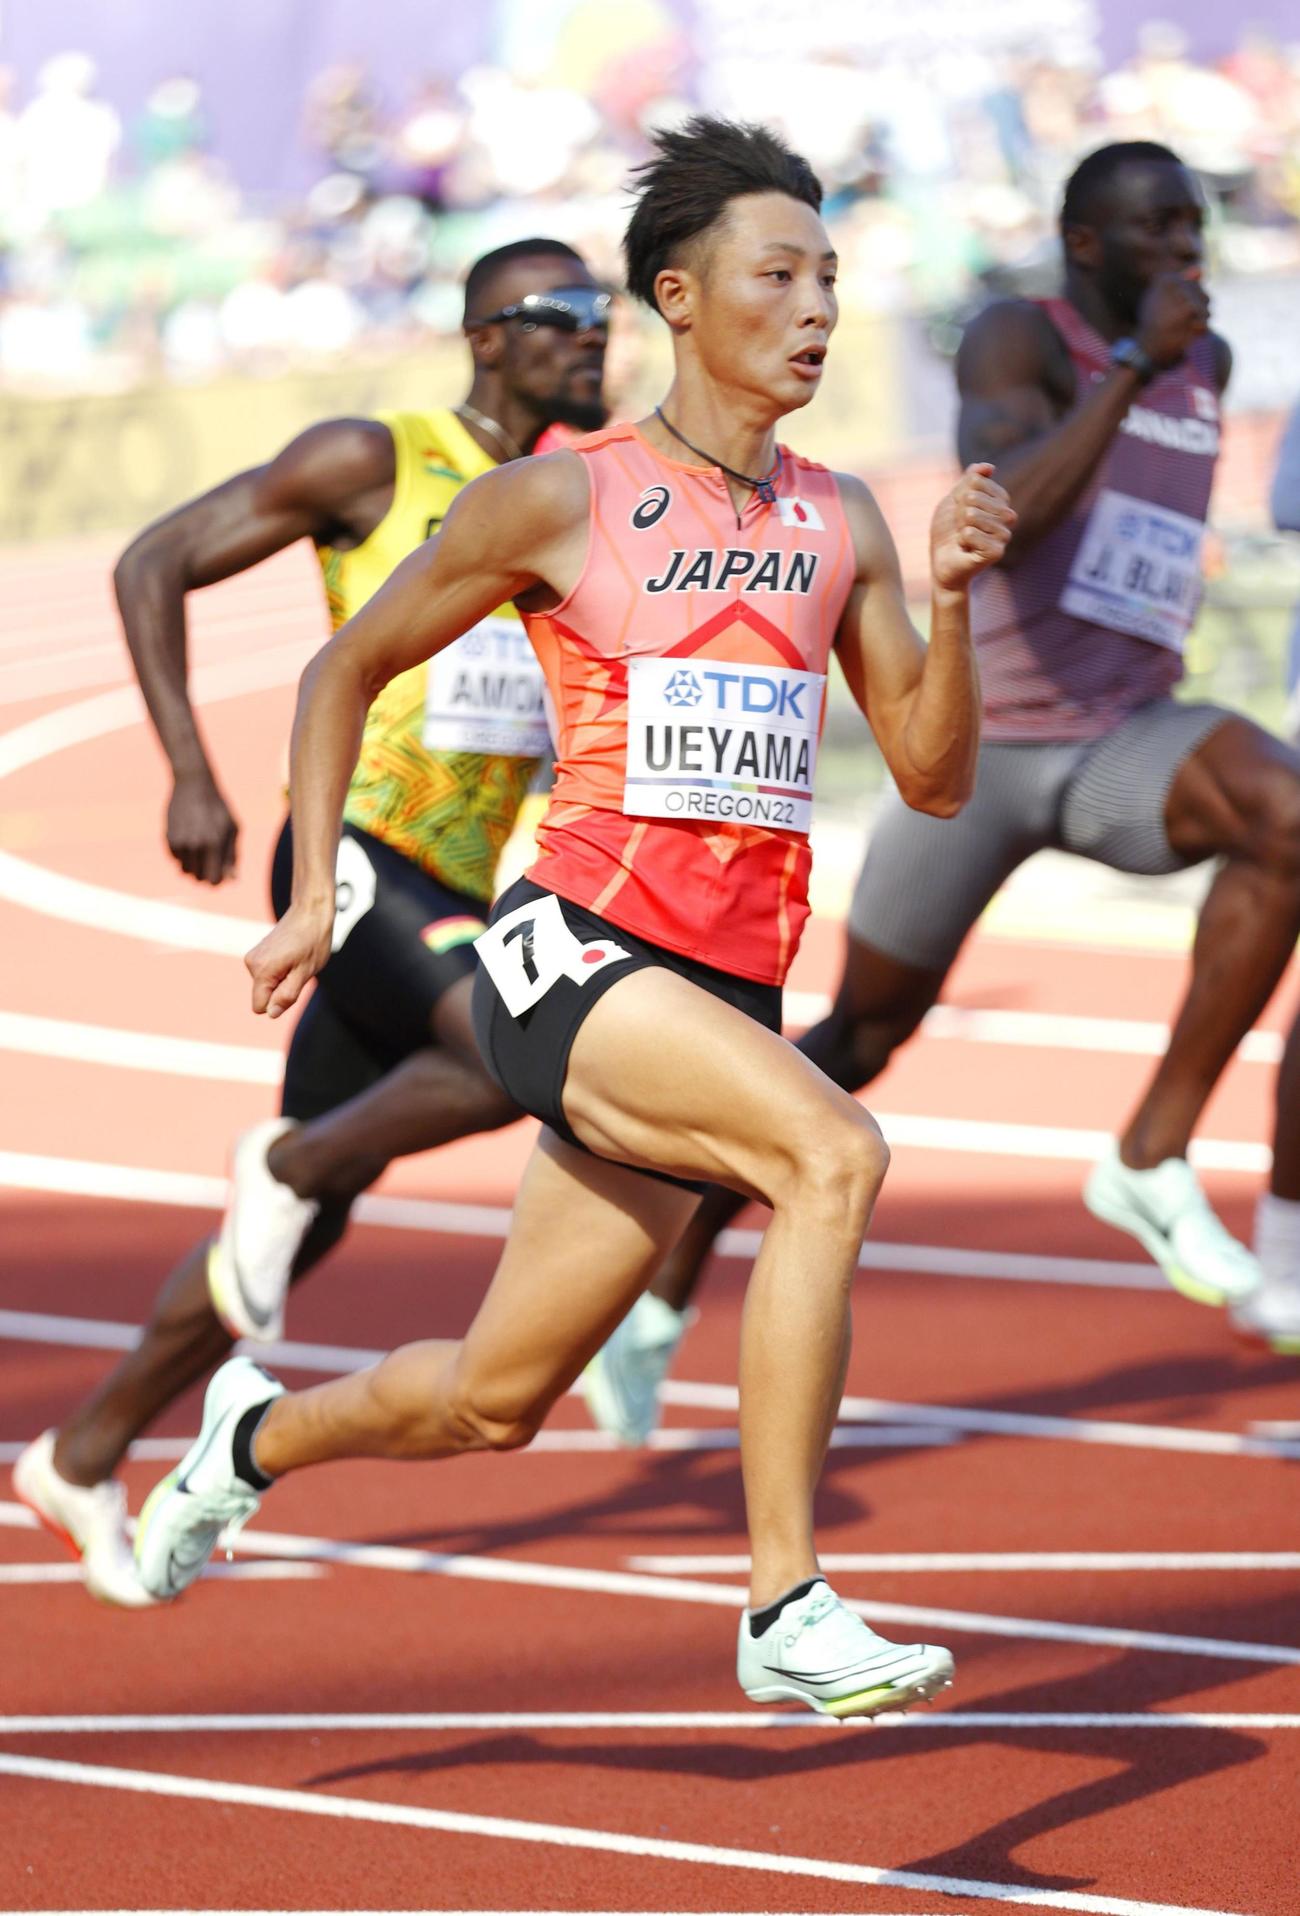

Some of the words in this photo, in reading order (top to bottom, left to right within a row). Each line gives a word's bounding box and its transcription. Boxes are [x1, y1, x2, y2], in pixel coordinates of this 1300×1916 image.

[646, 550, 818, 594] JAPAN
[703, 671, 807, 719] TDK
[645, 725, 809, 785] UEYAMA
[665, 791, 795, 823] OREGON22
[502, 917, 539, 986] 7
